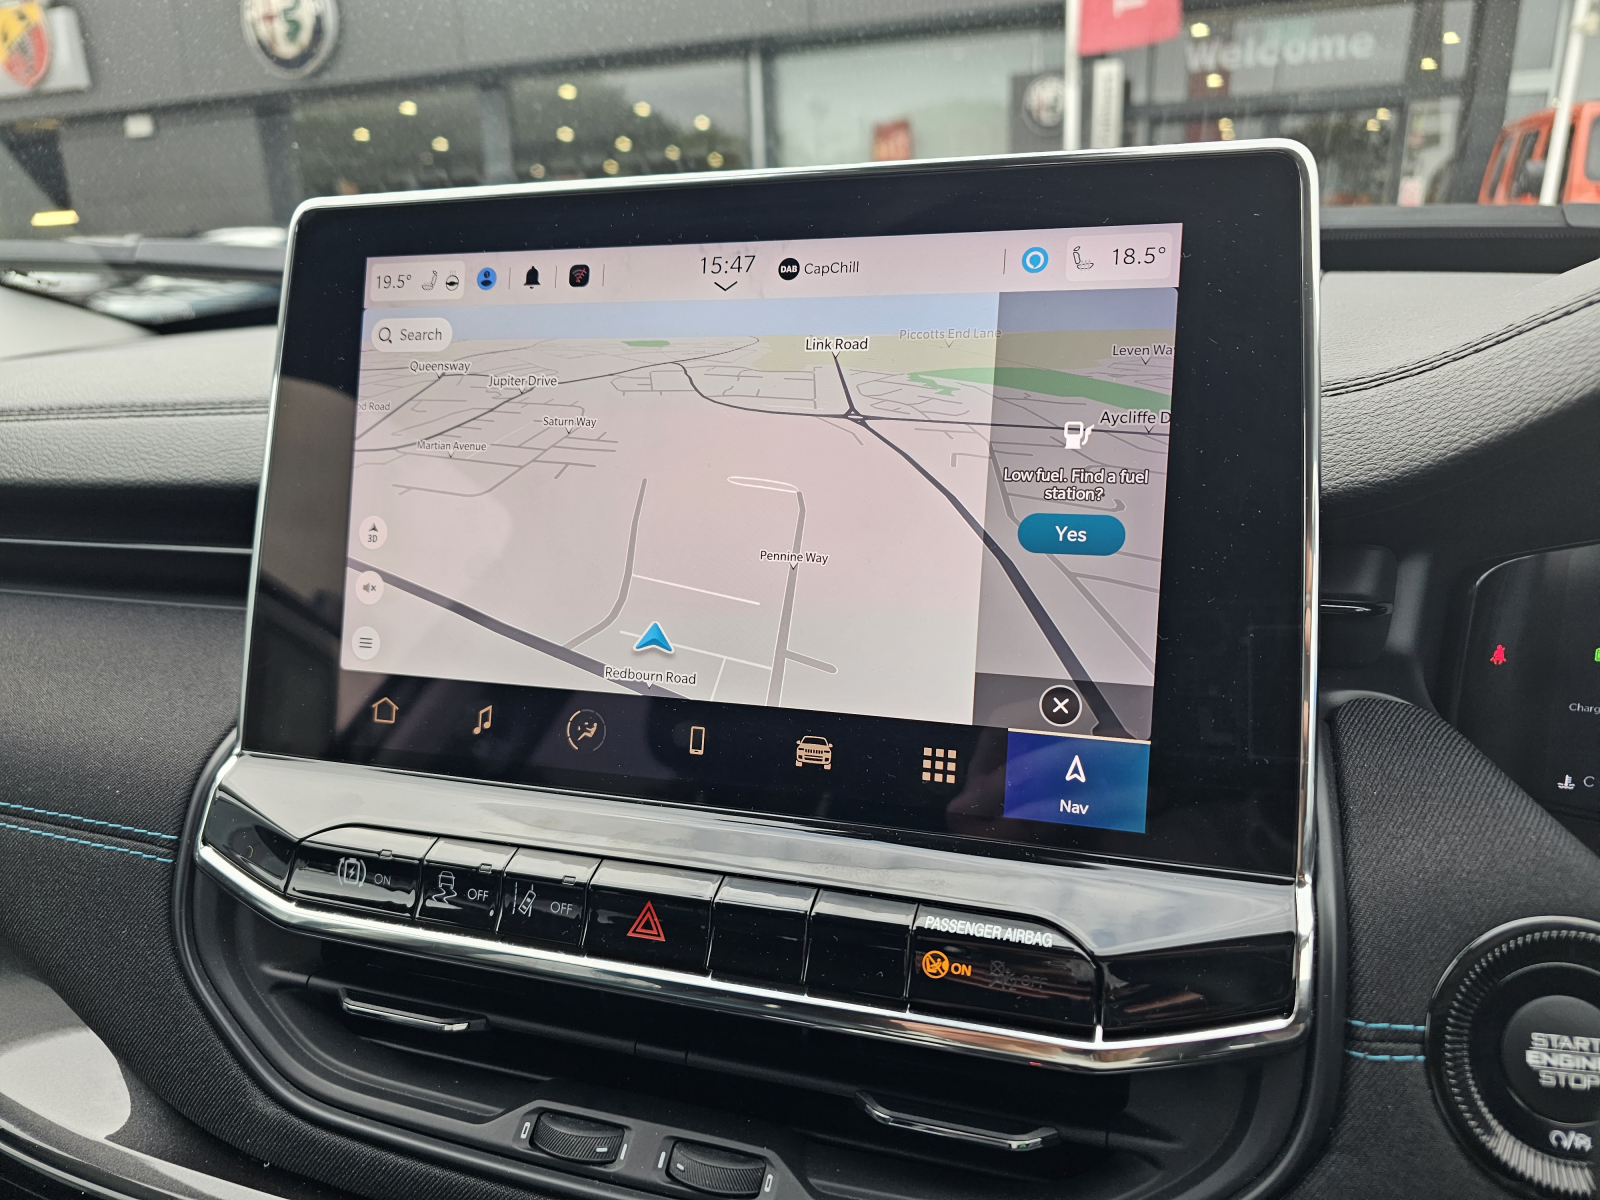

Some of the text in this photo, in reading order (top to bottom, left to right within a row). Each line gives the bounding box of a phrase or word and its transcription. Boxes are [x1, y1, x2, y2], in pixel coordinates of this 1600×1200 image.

[1187, 31, 1375, 69] Welcome
[1112, 245, 1166, 267] 18.5°
[700, 255, 756, 275] 15:47
[780, 261, 859, 276] DAB CapChill
[376, 273, 412, 290] 19.5°
[399, 328, 443, 342] Search
[899, 328, 1002, 340] Piccotts End Lane
[805, 338, 868, 351] Link Road
[1113, 344, 1175, 356] Leven Wa
[410, 360, 470, 373] Queensway
[488, 375, 557, 388] Jupiter Drive
[368, 401, 391, 411] Road
[543, 416, 597, 429] Saturn Way
[1100, 411, 1157, 427] Aycliffe
[417, 440, 487, 452] Martian Avenue
[1003, 469, 1149, 484] Low fuel. Find a fuel
[1044, 486, 1104, 502] station?
[367, 534, 378, 543] 3D
[1055, 525, 1087, 543] Yes
[760, 550, 829, 566] Pennine Way
[605, 667, 696, 686] Redbourn Road
[1583, 775, 1595, 788] C
[1059, 800, 1089, 815] Nav
[374, 874, 391, 886] ON
[468, 888, 489, 900] OFF
[550, 902, 573, 915] OFF
[925, 915, 1054, 948] PASSENGER AIRBAG
[951, 962, 971, 977] ON
